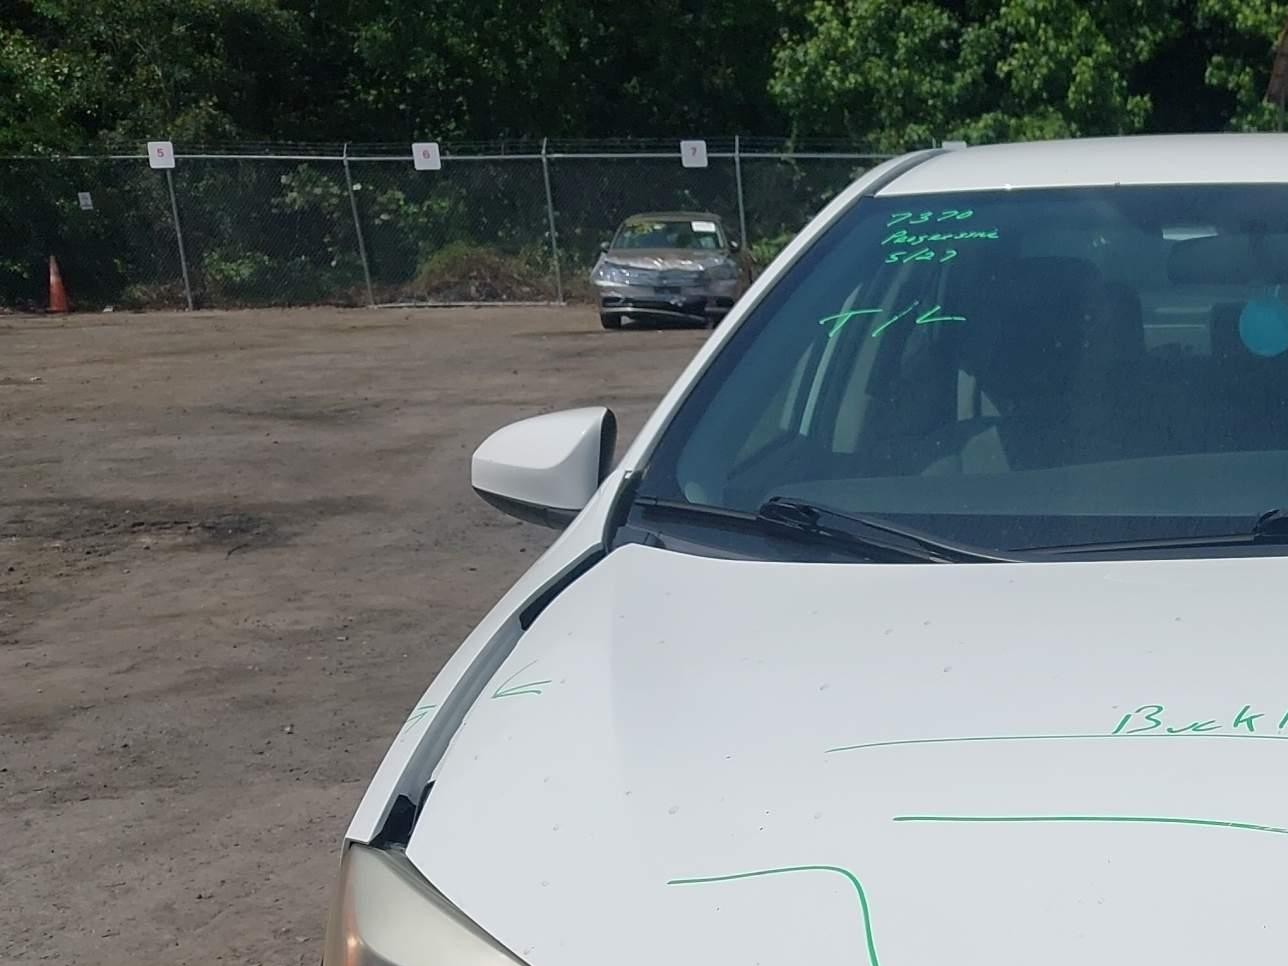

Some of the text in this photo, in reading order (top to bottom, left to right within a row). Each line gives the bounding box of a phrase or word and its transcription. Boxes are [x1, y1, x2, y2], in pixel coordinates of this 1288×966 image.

[156, 147, 165, 158] 5
[690, 146, 697, 157] 7
[886, 210, 974, 227] 7370
